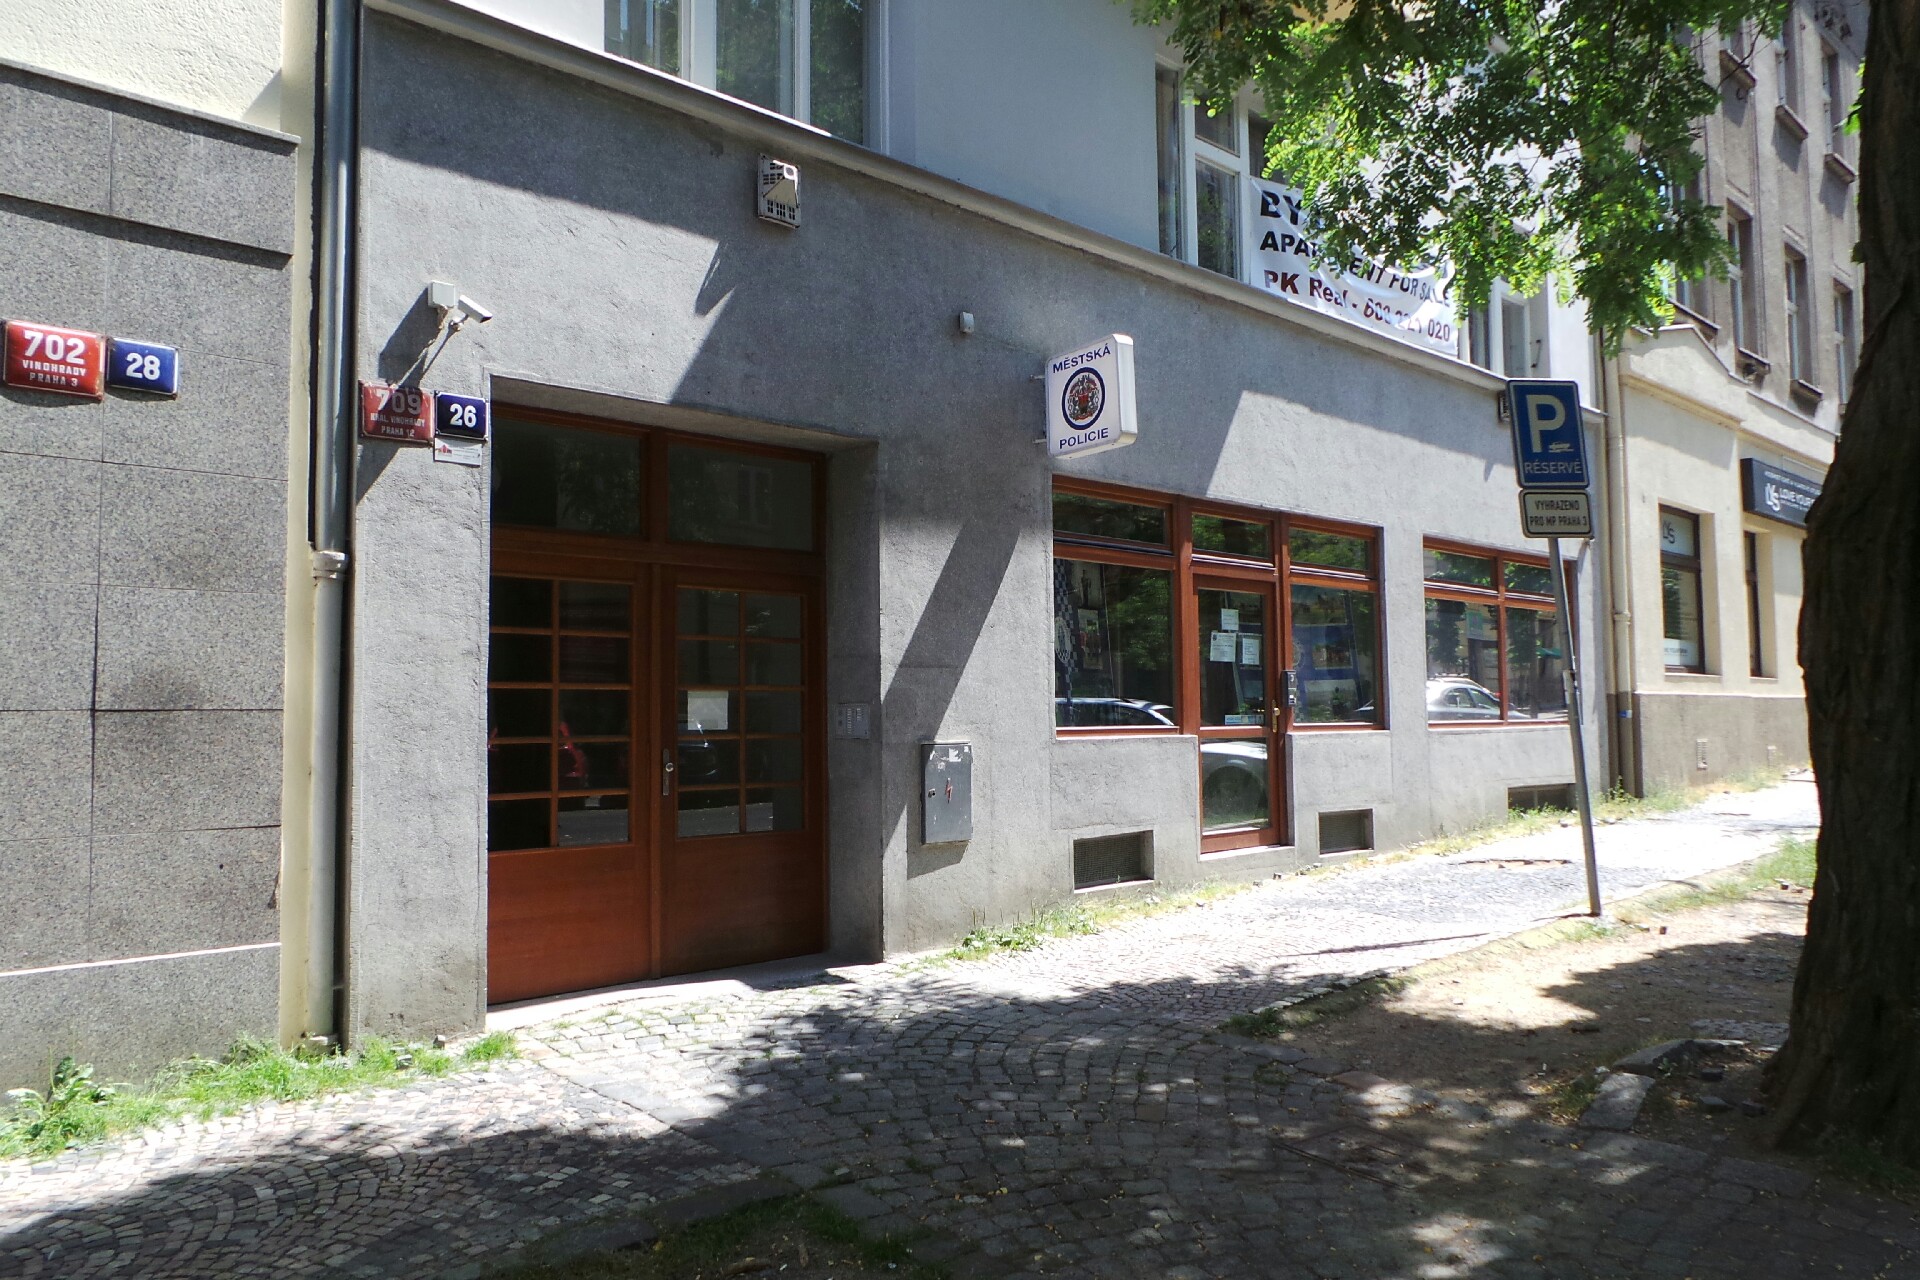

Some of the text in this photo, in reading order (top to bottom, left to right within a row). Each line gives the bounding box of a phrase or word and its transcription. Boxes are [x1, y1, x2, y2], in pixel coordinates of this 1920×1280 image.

[1263, 269, 1300, 294] PK
[1428, 319, 1451, 342] 020
[23, 331, 86, 365] 702
[1052, 343, 1111, 374] MĚSTSKÁ
[22, 359, 86, 376] VINOHRADY
[126, 353, 161, 380] 28
[29, 371, 78, 387] PRAHA 3
[376, 389, 422, 415] 709
[390, 415, 426, 427] VINOHRADY
[450, 403, 477, 428] 26
[1526, 395, 1566, 453] P
[381, 425, 404, 436] PRAHA
[1059, 428, 1109, 449] POLICIE
[1524, 459, 1582, 474] RÉSERVÉ
[1534, 499, 1580, 511] VYHRAZENO
[1529, 515, 1544, 526] PRO
[1558, 515, 1580, 526] PRAHA
